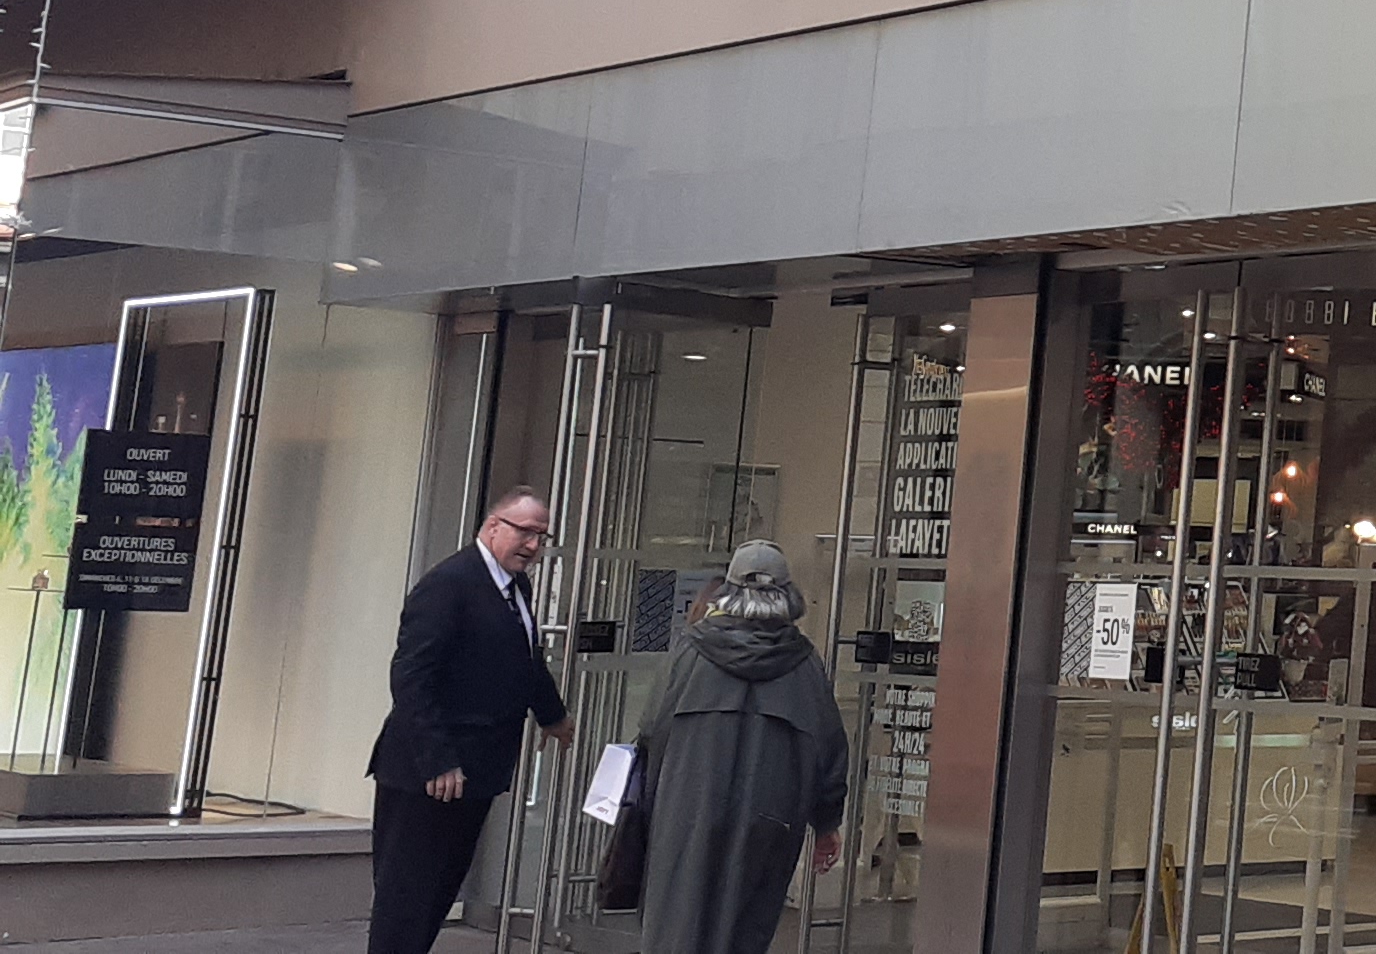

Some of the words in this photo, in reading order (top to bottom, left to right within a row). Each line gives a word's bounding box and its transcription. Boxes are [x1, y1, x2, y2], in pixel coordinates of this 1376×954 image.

[1103, 364, 1192, 385] ANE
[1303, 372, 1327, 397] CHANEL
[900, 409, 915, 436] LA
[127, 448, 172, 461] OUVERT
[896, 442, 958, 470] APPLICATI
[103, 468, 138, 481] LUNDI
[146, 470, 188, 483] SAMEDI
[103, 482, 140, 495] 10H00
[148, 483, 187, 497] 20H00
[893, 476, 951, 512] GALERI
[888, 519, 950, 555] LAFAYET
[1087, 523, 1138, 535] CHANEL
[99, 535, 176, 551] OUVERTURES
[82, 548, 188, 564] EXCEPTIONNELLES
[1095, 618, 1131, 646] -50%
[892, 651, 940, 665] sisle
